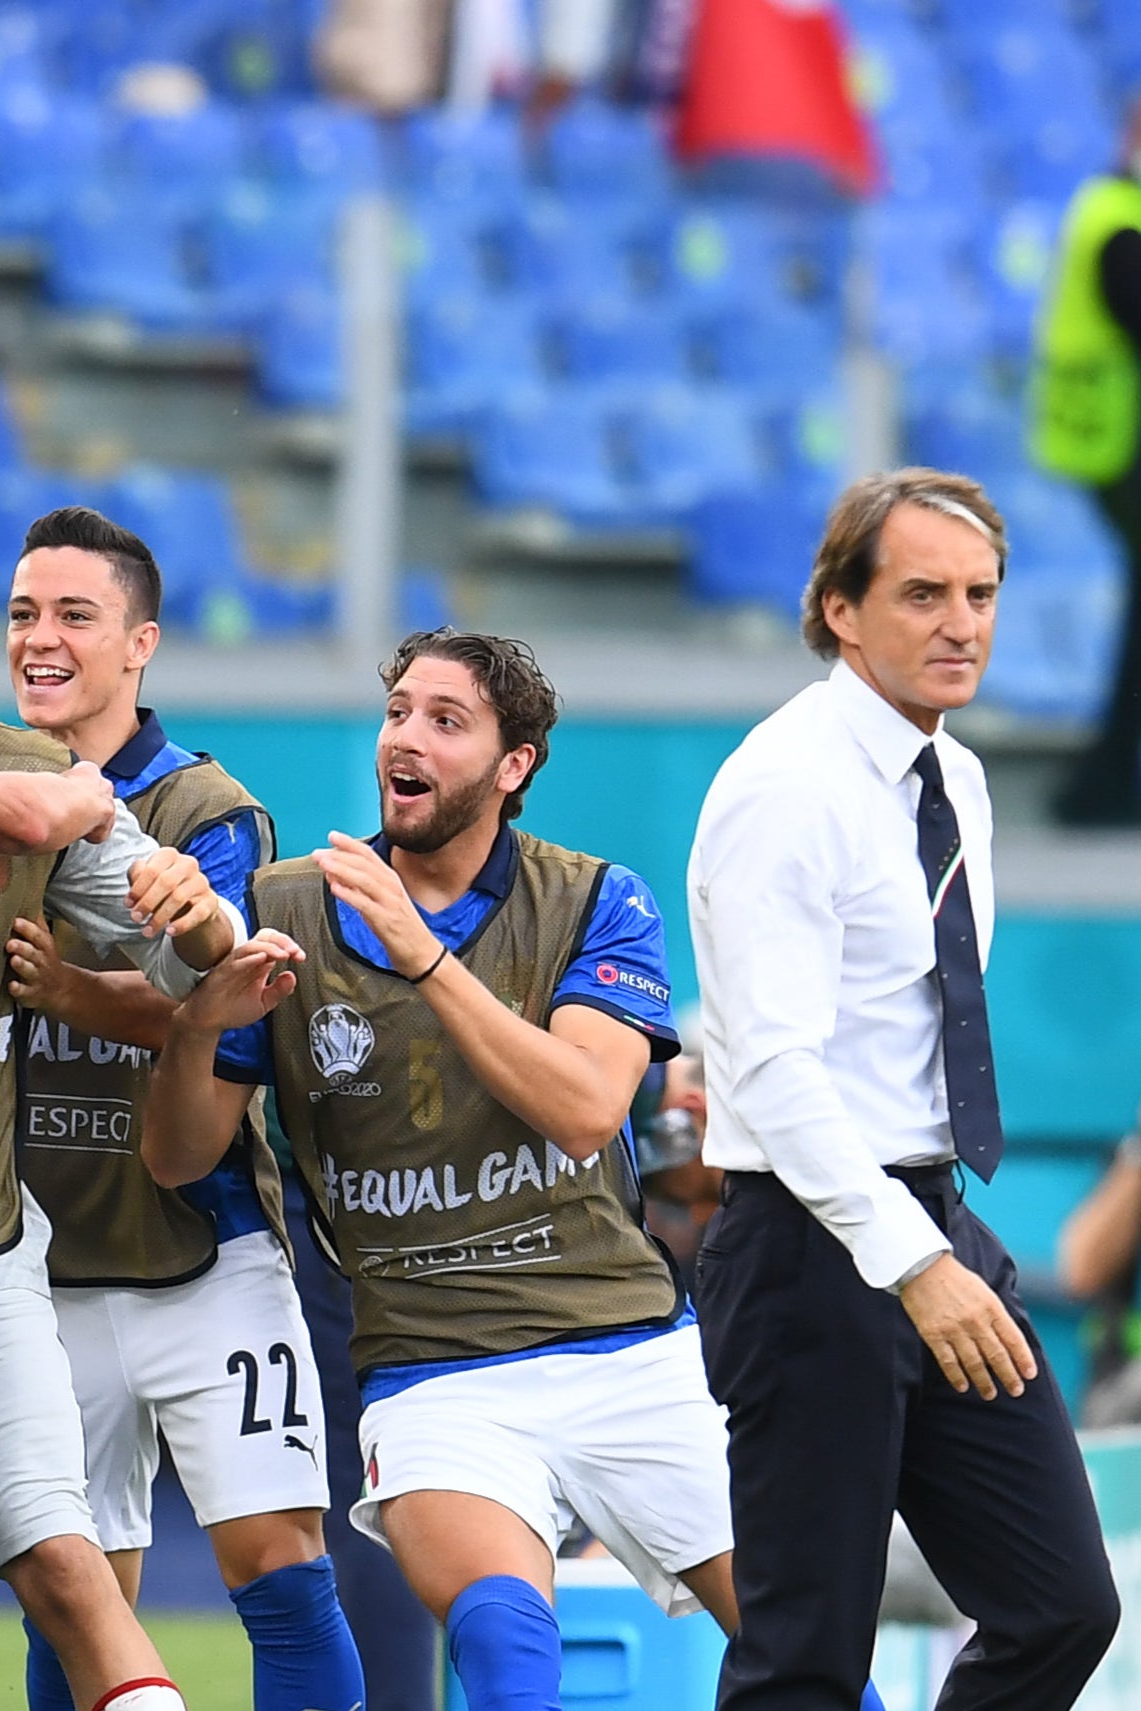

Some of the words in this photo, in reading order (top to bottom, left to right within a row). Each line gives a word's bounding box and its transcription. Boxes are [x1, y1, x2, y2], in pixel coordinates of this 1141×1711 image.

[620, 971, 670, 1002] RESPECT
[410, 1039, 444, 1132] 5
[321, 1152, 473, 1221] #EQUAL
[476, 1138, 600, 1202] GAM
[226, 1341, 309, 1437] 22
